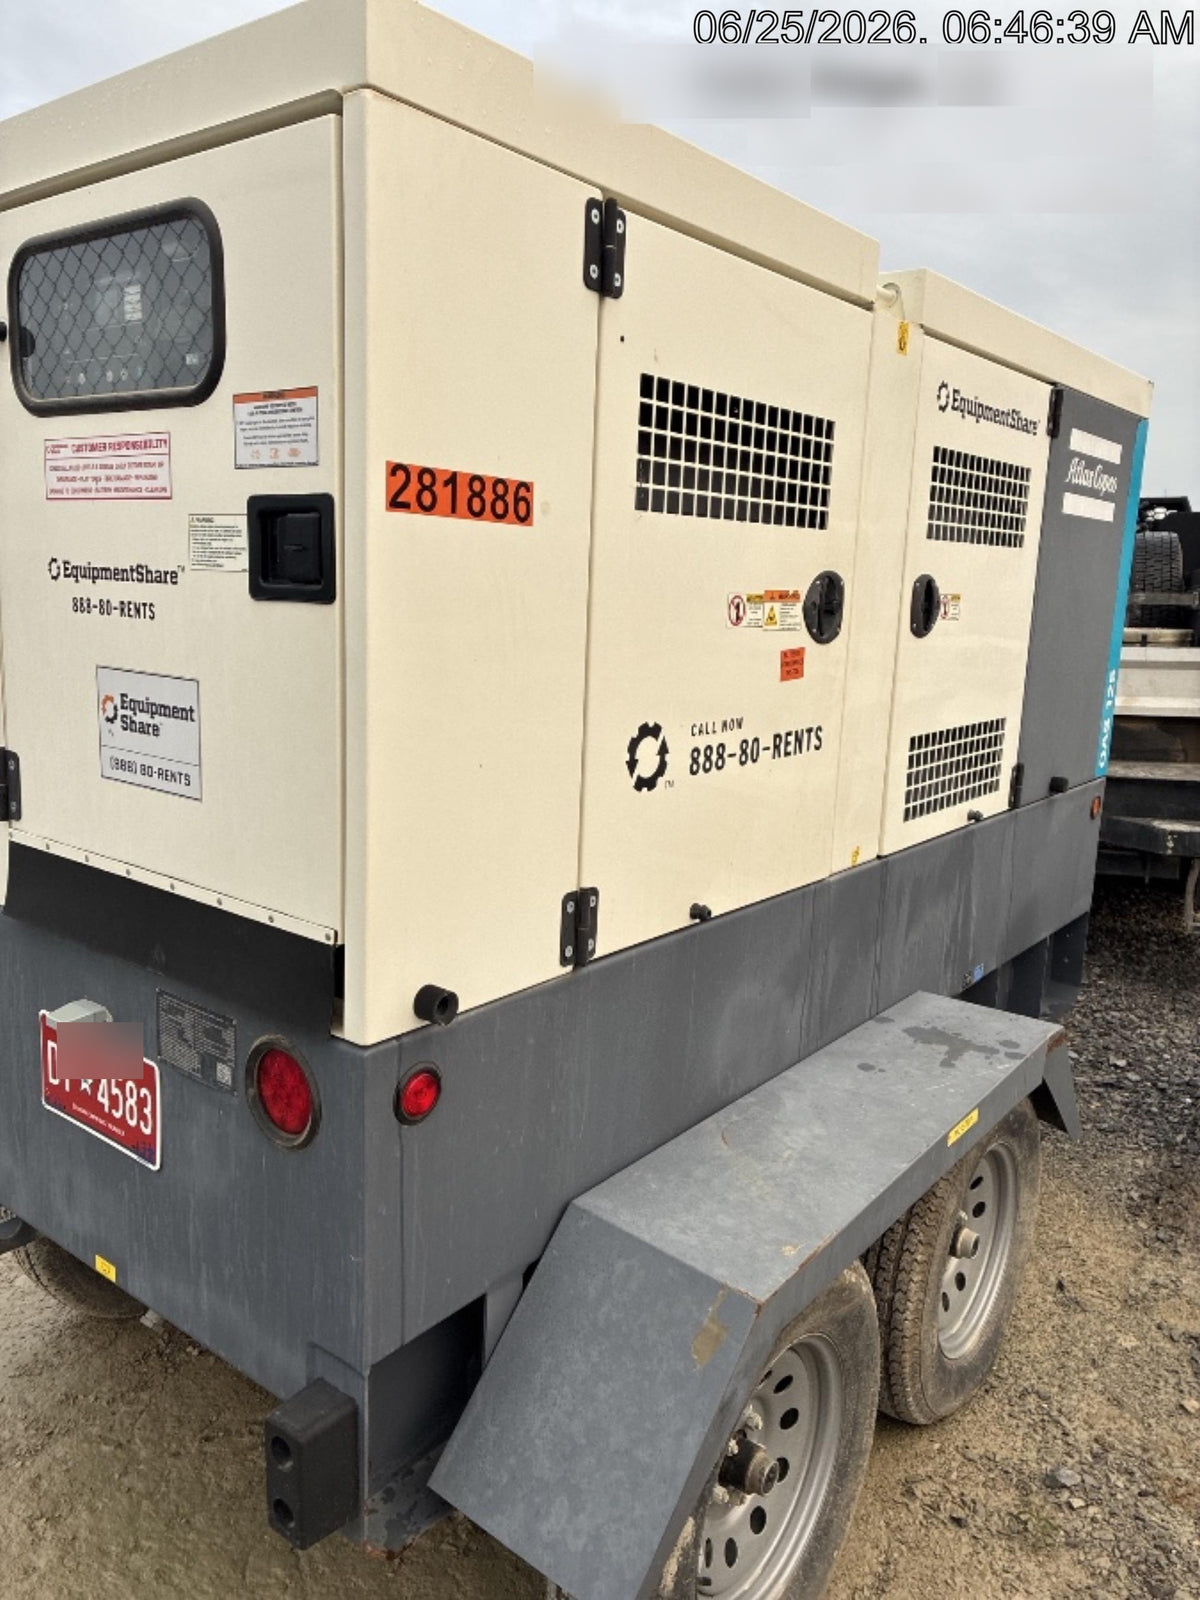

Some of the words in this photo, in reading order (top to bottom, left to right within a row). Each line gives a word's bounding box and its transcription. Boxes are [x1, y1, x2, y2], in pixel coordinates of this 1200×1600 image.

[951, 388, 1037, 436] EquipmentShare
[389, 463, 531, 523] 281886
[62, 560, 178, 585] EquipmentShare
[72, 597, 155, 620] 888-80-RENTS
[120, 693, 195, 722] Equipment
[120, 714, 160, 736] Share
[691, 721, 717, 737] CALL
[721, 717, 744, 733] NOW
[689, 725, 822, 776] 888-80-RENTS
[140, 764, 191, 786] 80-RENTS
